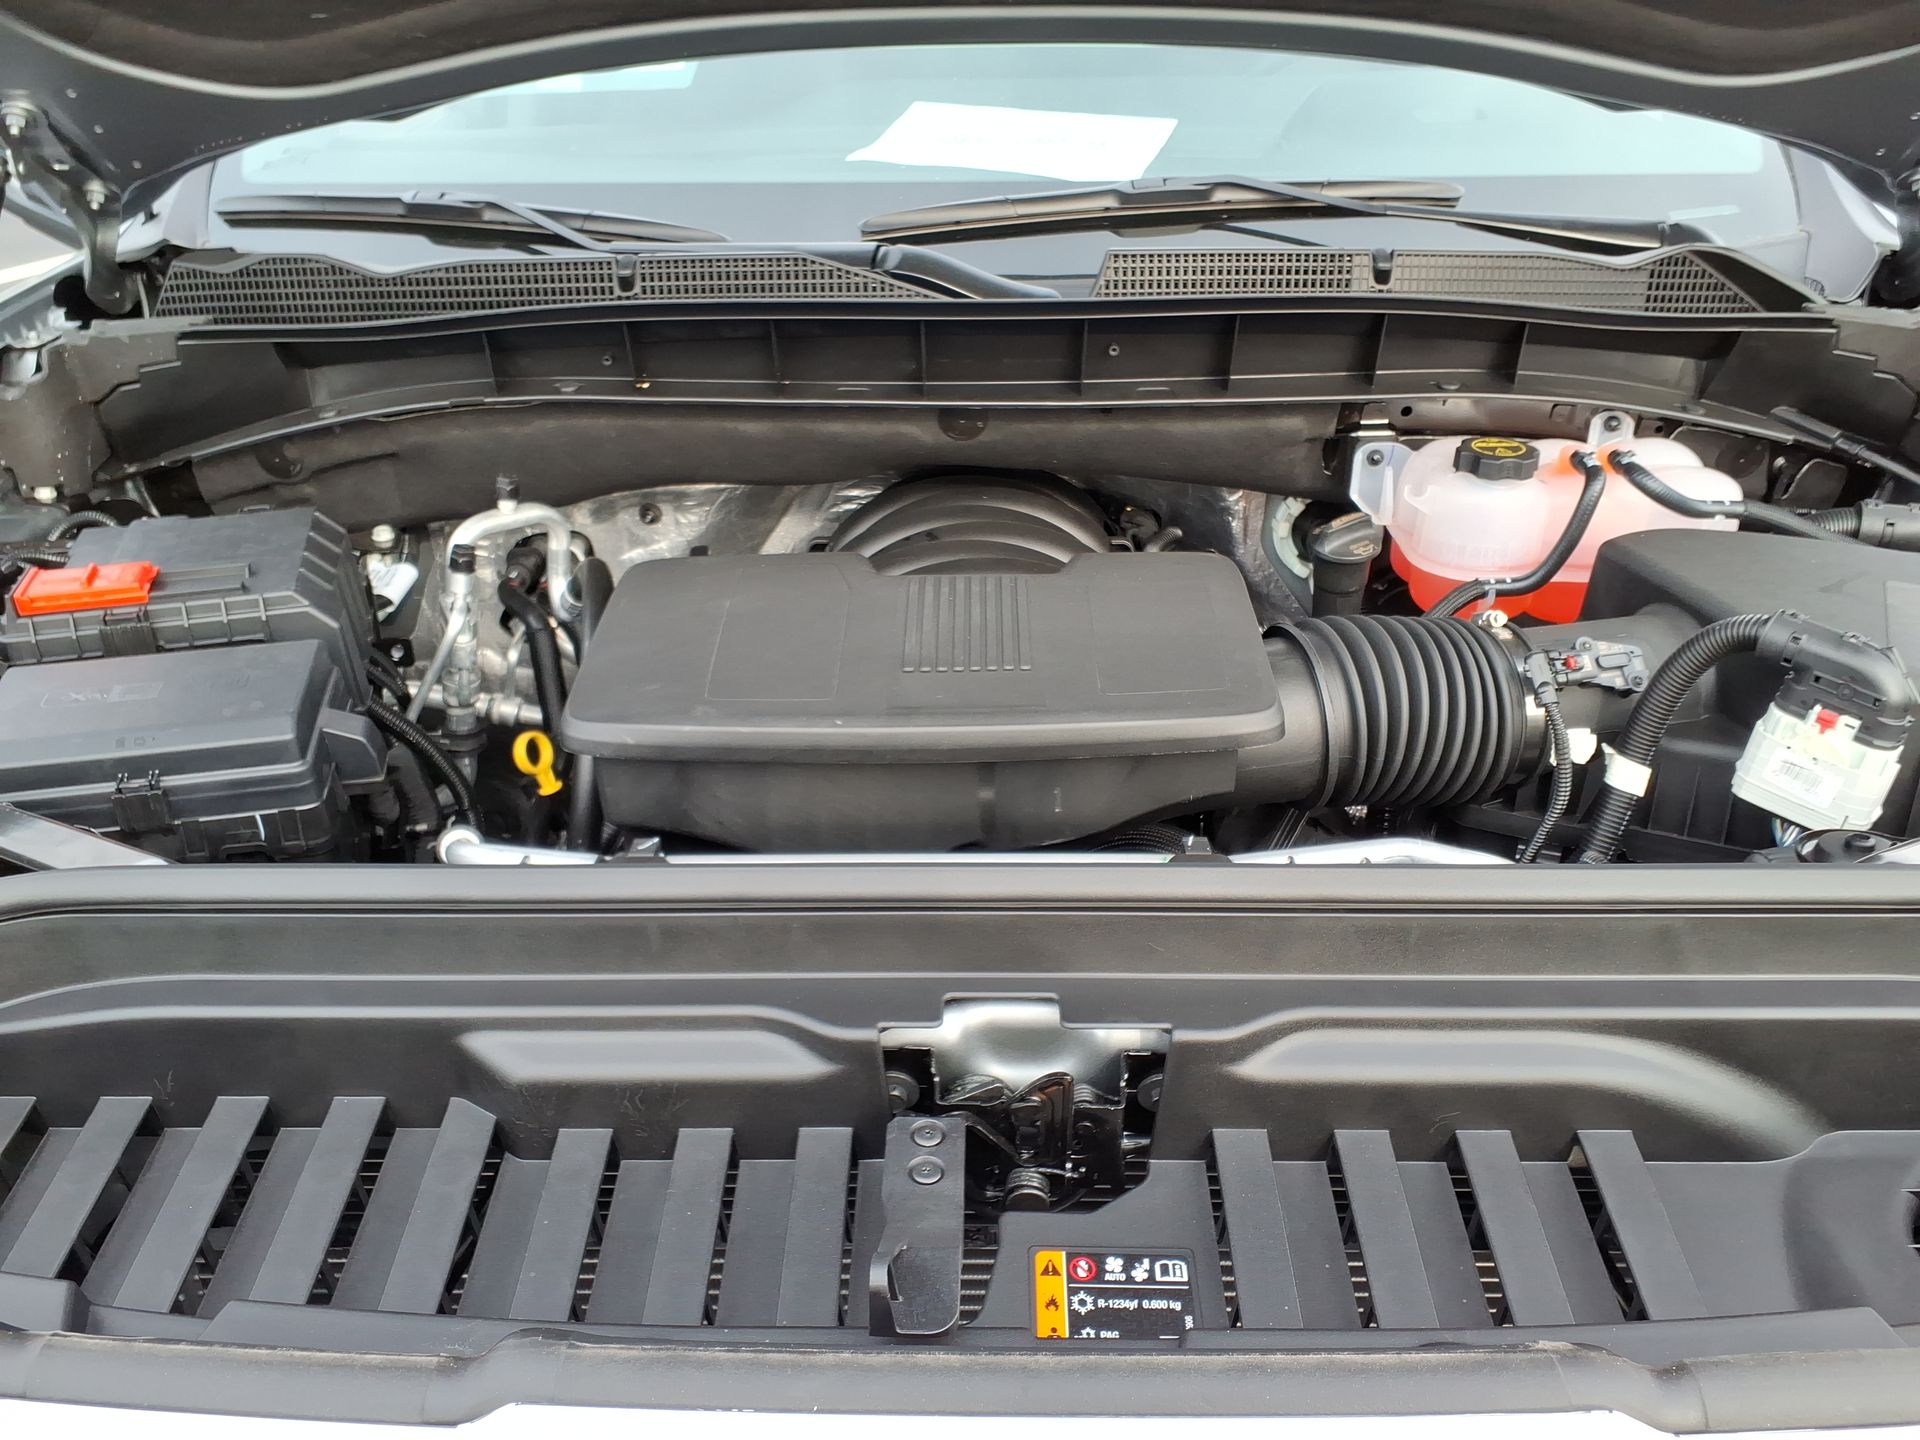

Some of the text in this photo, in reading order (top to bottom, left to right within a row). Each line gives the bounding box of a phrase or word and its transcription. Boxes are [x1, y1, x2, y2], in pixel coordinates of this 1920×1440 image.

[1104, 1272, 1126, 1282] AUTO
[1097, 1299, 1182, 1311] R-1234yf 0.600 kg
